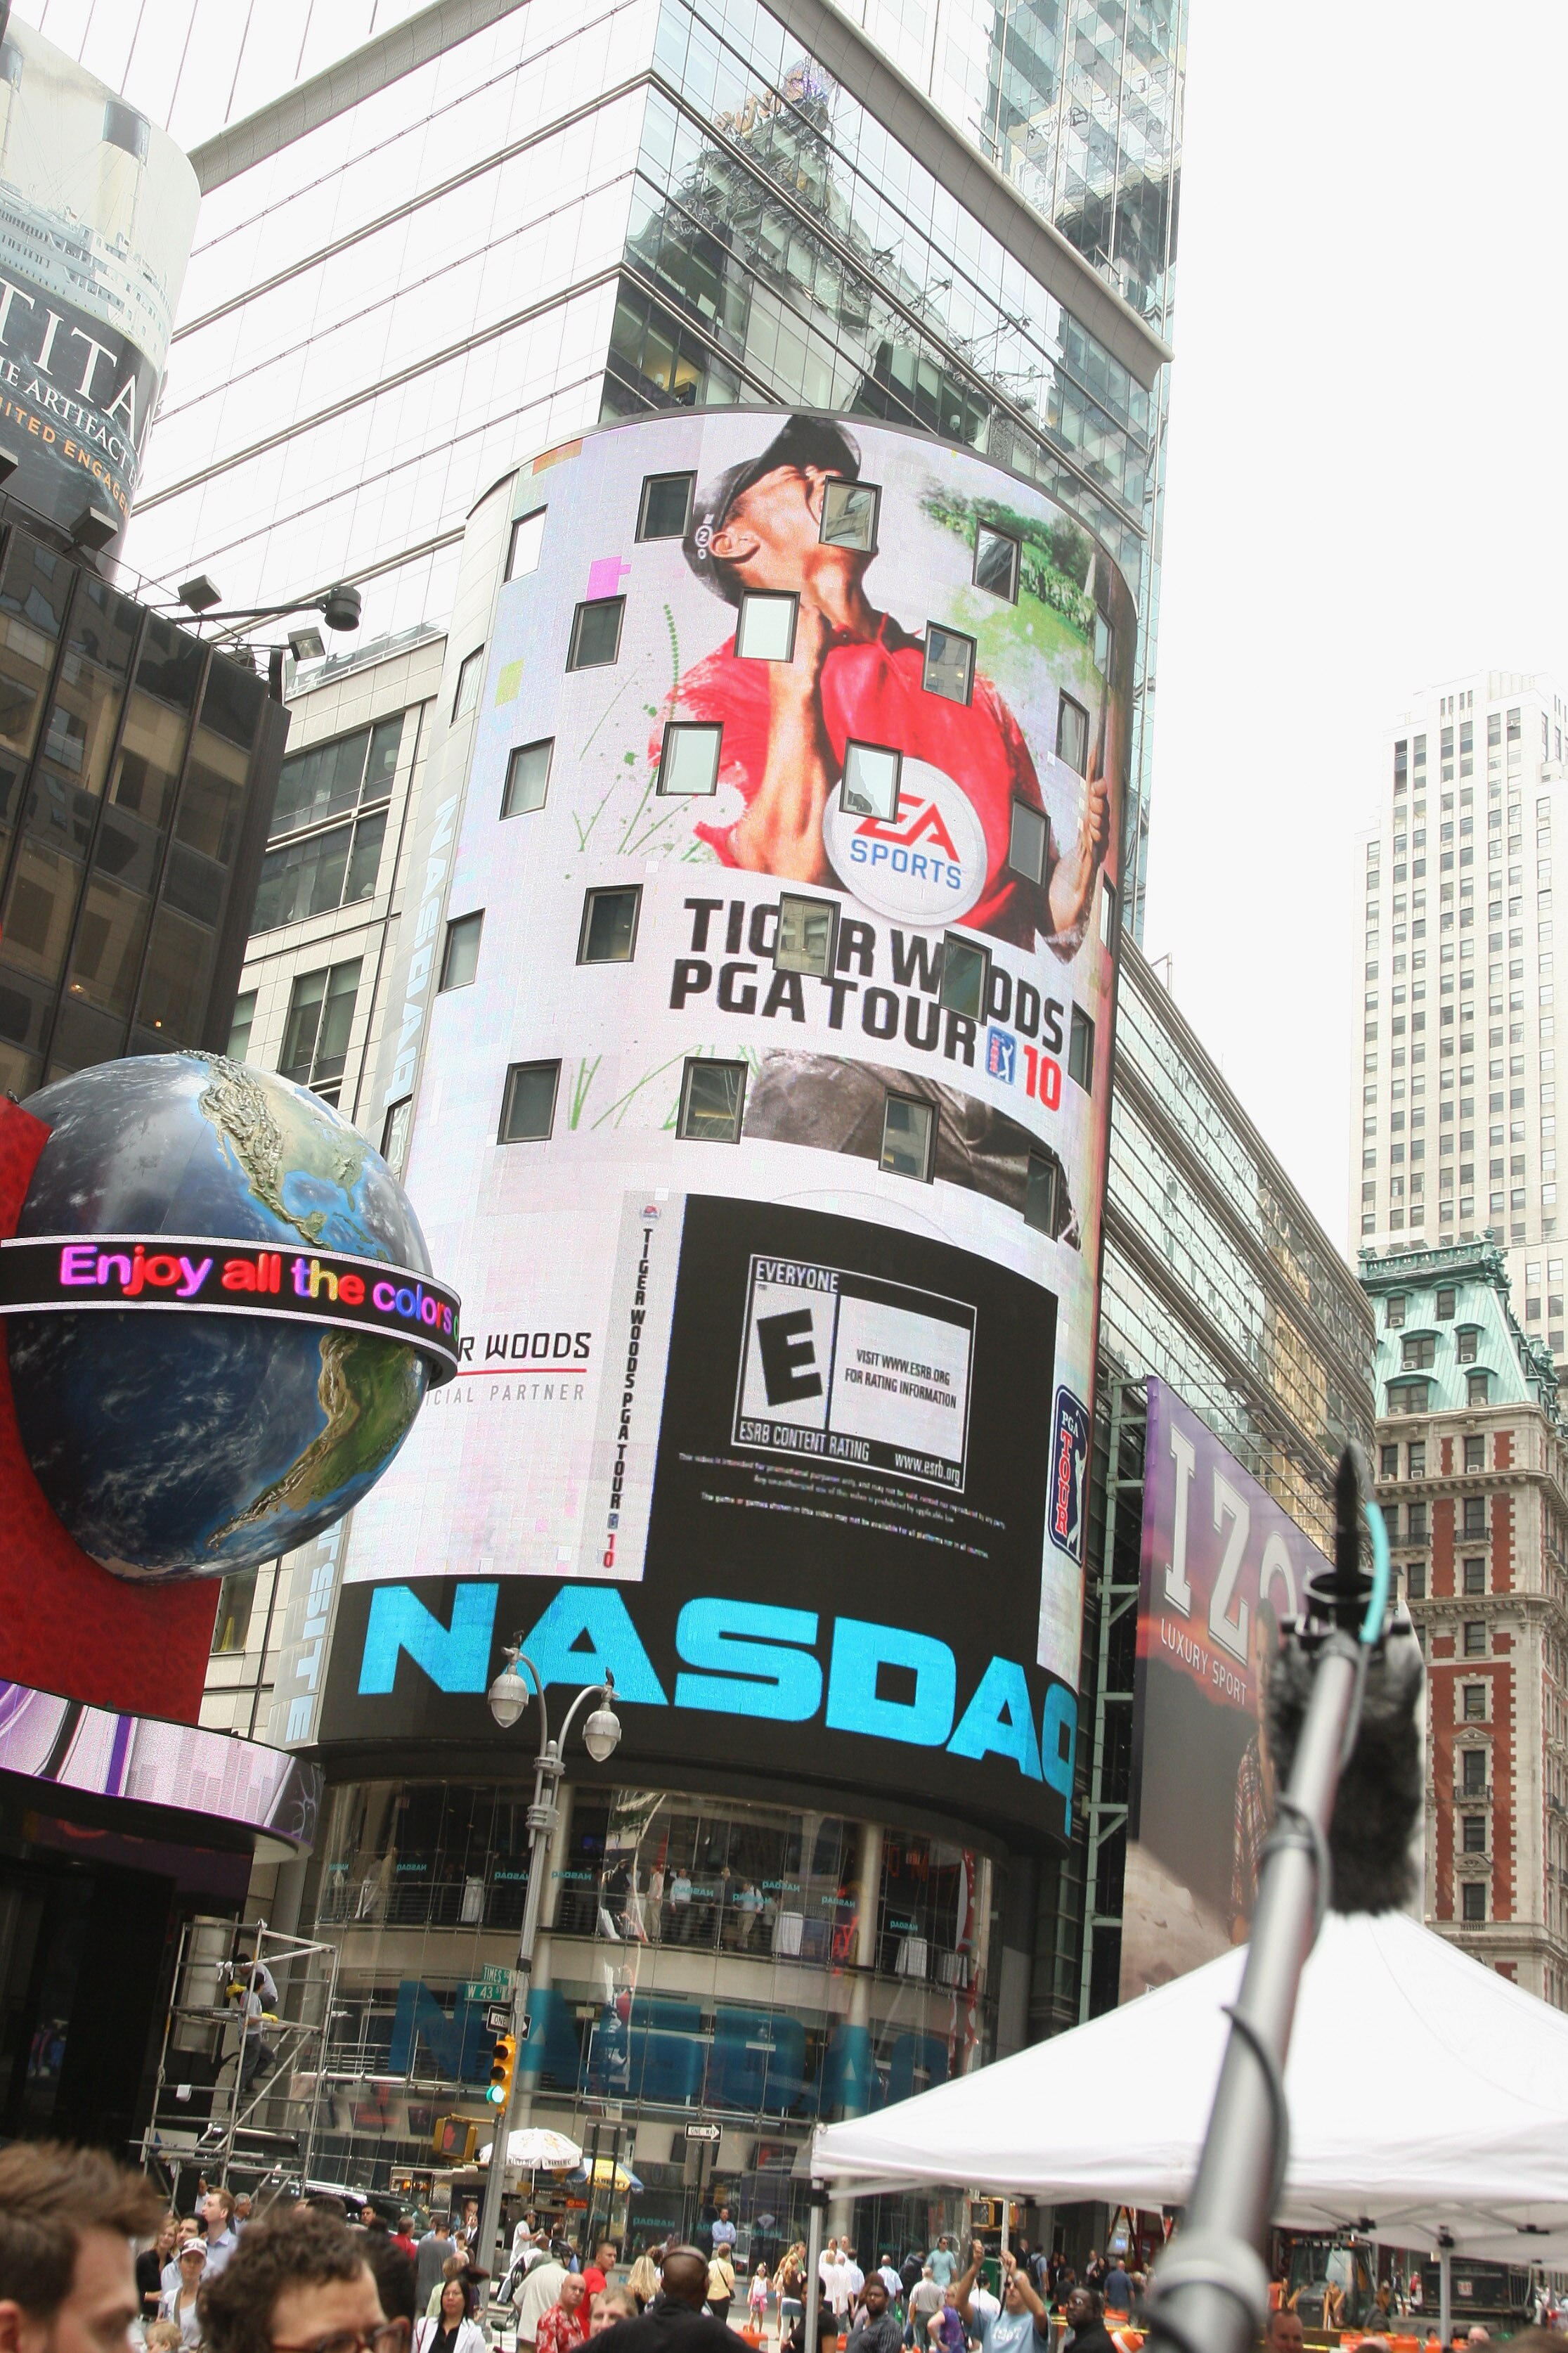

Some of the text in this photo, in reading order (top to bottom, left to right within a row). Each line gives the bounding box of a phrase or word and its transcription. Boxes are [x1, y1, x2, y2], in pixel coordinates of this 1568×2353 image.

[24, 378, 129, 470] ARTIFACT
[855, 793, 961, 863] EA
[850, 838, 963, 890] SPORTS
[385, 793, 458, 1105] NASDAQ
[685, 897, 1063, 1055] TIGR WODS
[669, 958, 806, 1024] PGA
[821, 977, 976, 1068] TOUR
[1023, 1045, 1062, 1112] 10
[60, 1244, 213, 1297] Enjoy
[221, 1252, 282, 1294] all
[292, 1257, 365, 1306] the
[372, 1281, 452, 1337] colors
[756, 1260, 839, 1293] EVERYONE
[485, 1332, 592, 1362] WOODS
[625, 1310, 646, 1388] WOODS
[757, 1308, 824, 1407] E
[857, 1349, 951, 1386] VISIT WWW.ESRB.ORG
[490, 1384, 585, 1402] PARTNER
[845, 1367, 957, 1409] FOR RATING INFORMATION
[618, 1392, 633, 1440] PGA
[739, 1420, 870, 1462] ESRB CONTENT RATING
[1062, 1410, 1079, 1438] PGA
[895, 1452, 961, 1487] www.esrb.org
[1055, 1428, 1073, 1538] TOUR
[1160, 1618, 1247, 1706] LUXURY SPORT
[357, 1582, 1077, 1838] NASDAQ
[468, 1985, 477, 1999] W
[479, 1985, 493, 1999] 43
[484, 1966, 503, 1983] TIMES
[494, 2015, 506, 2025] ONE
